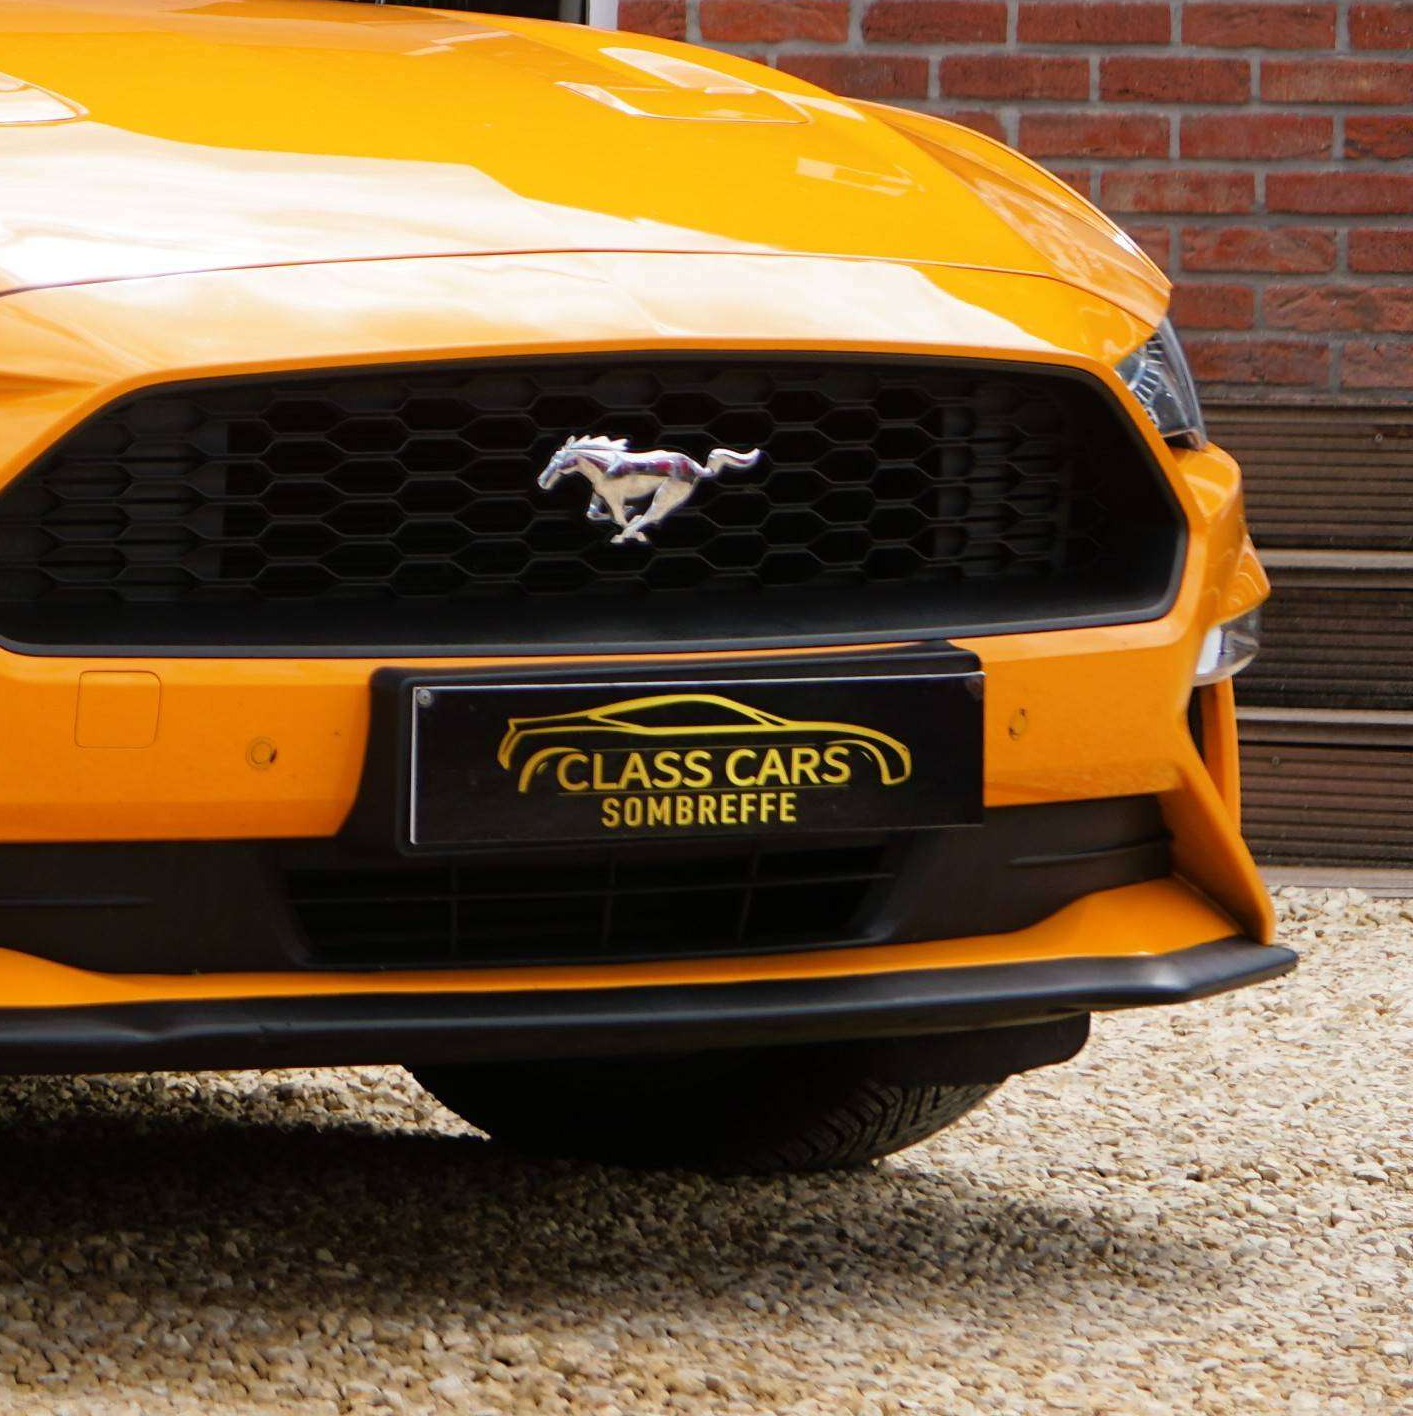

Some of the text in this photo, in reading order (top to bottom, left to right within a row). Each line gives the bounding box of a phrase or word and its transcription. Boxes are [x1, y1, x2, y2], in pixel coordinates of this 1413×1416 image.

[556, 746, 852, 792] CLASS CARS
[600, 792, 798, 828] SOMBREFFE
